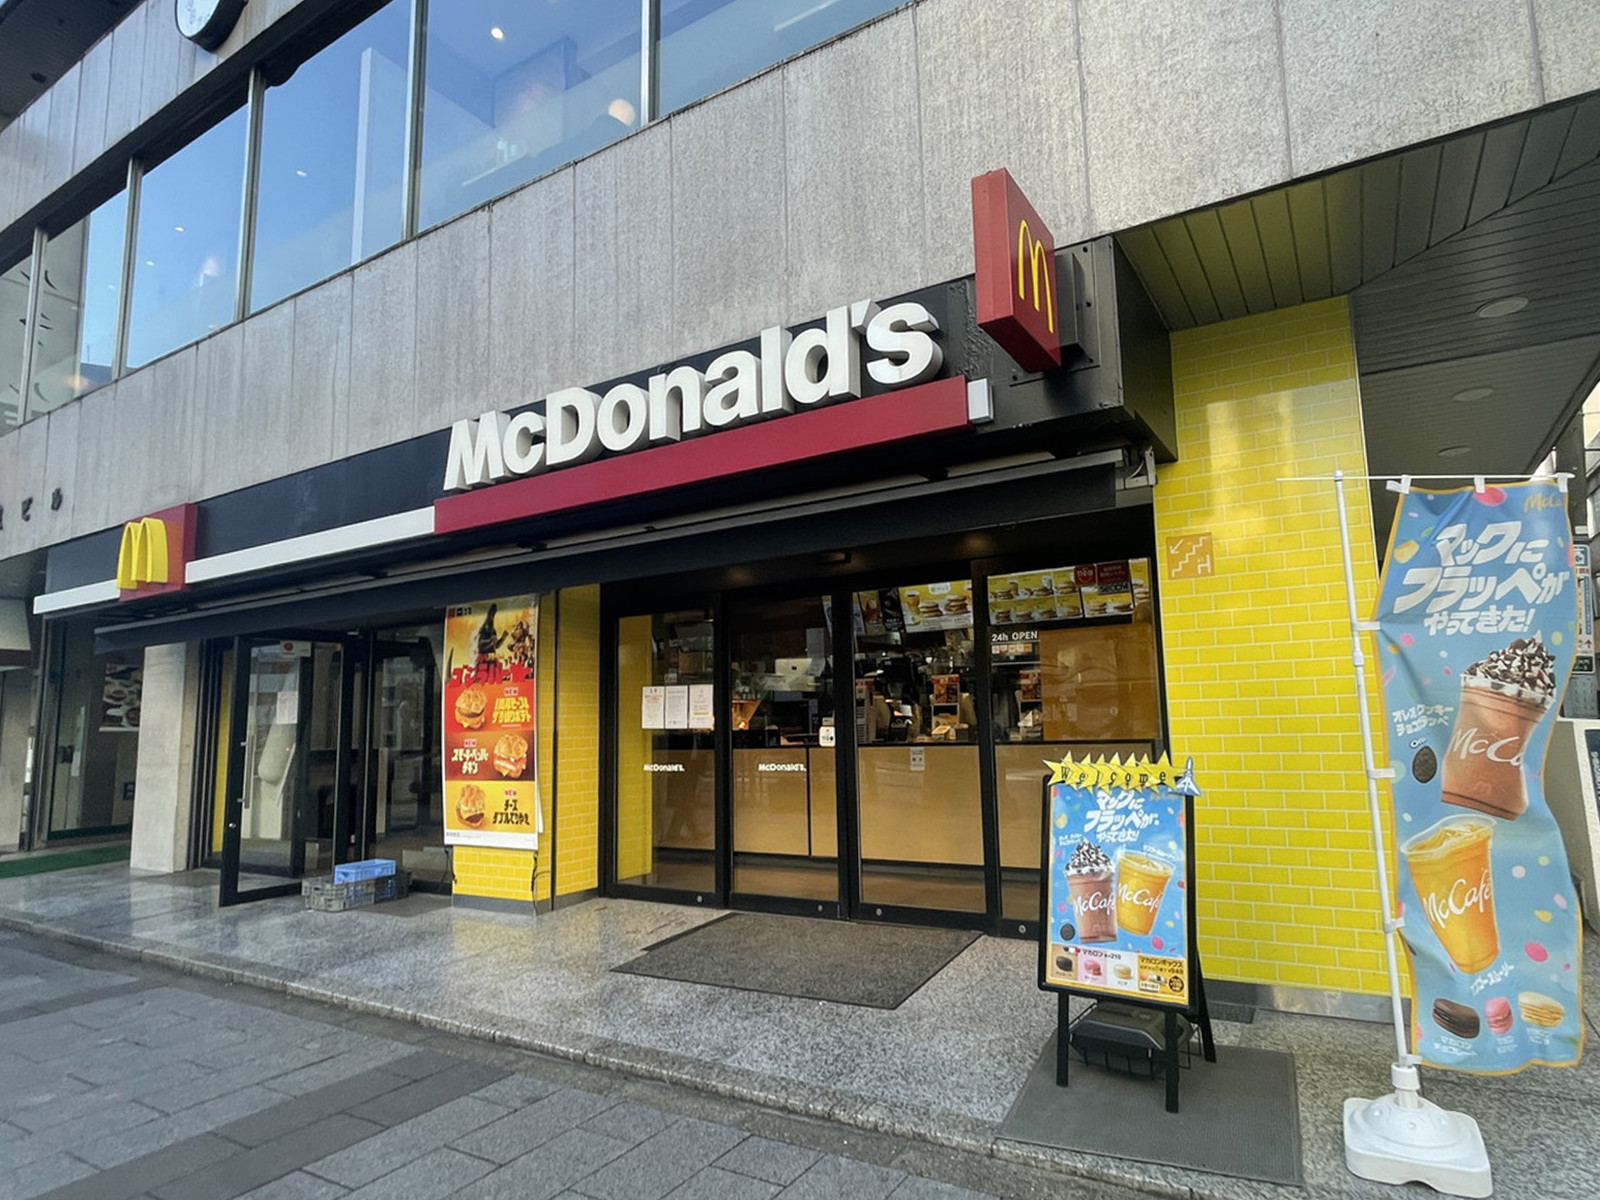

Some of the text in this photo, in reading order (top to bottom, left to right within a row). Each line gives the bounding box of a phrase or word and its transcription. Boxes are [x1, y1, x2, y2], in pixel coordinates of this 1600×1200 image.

[443, 299, 944, 491] McDonald's
[1435, 520, 1550, 567] マックに
[1393, 563, 1570, 614] フラッペが
[991, 630, 1038, 642] 24h OPEN
[1423, 604, 1536, 637] やってきた!
[1060, 765, 1167, 786] Welcome
